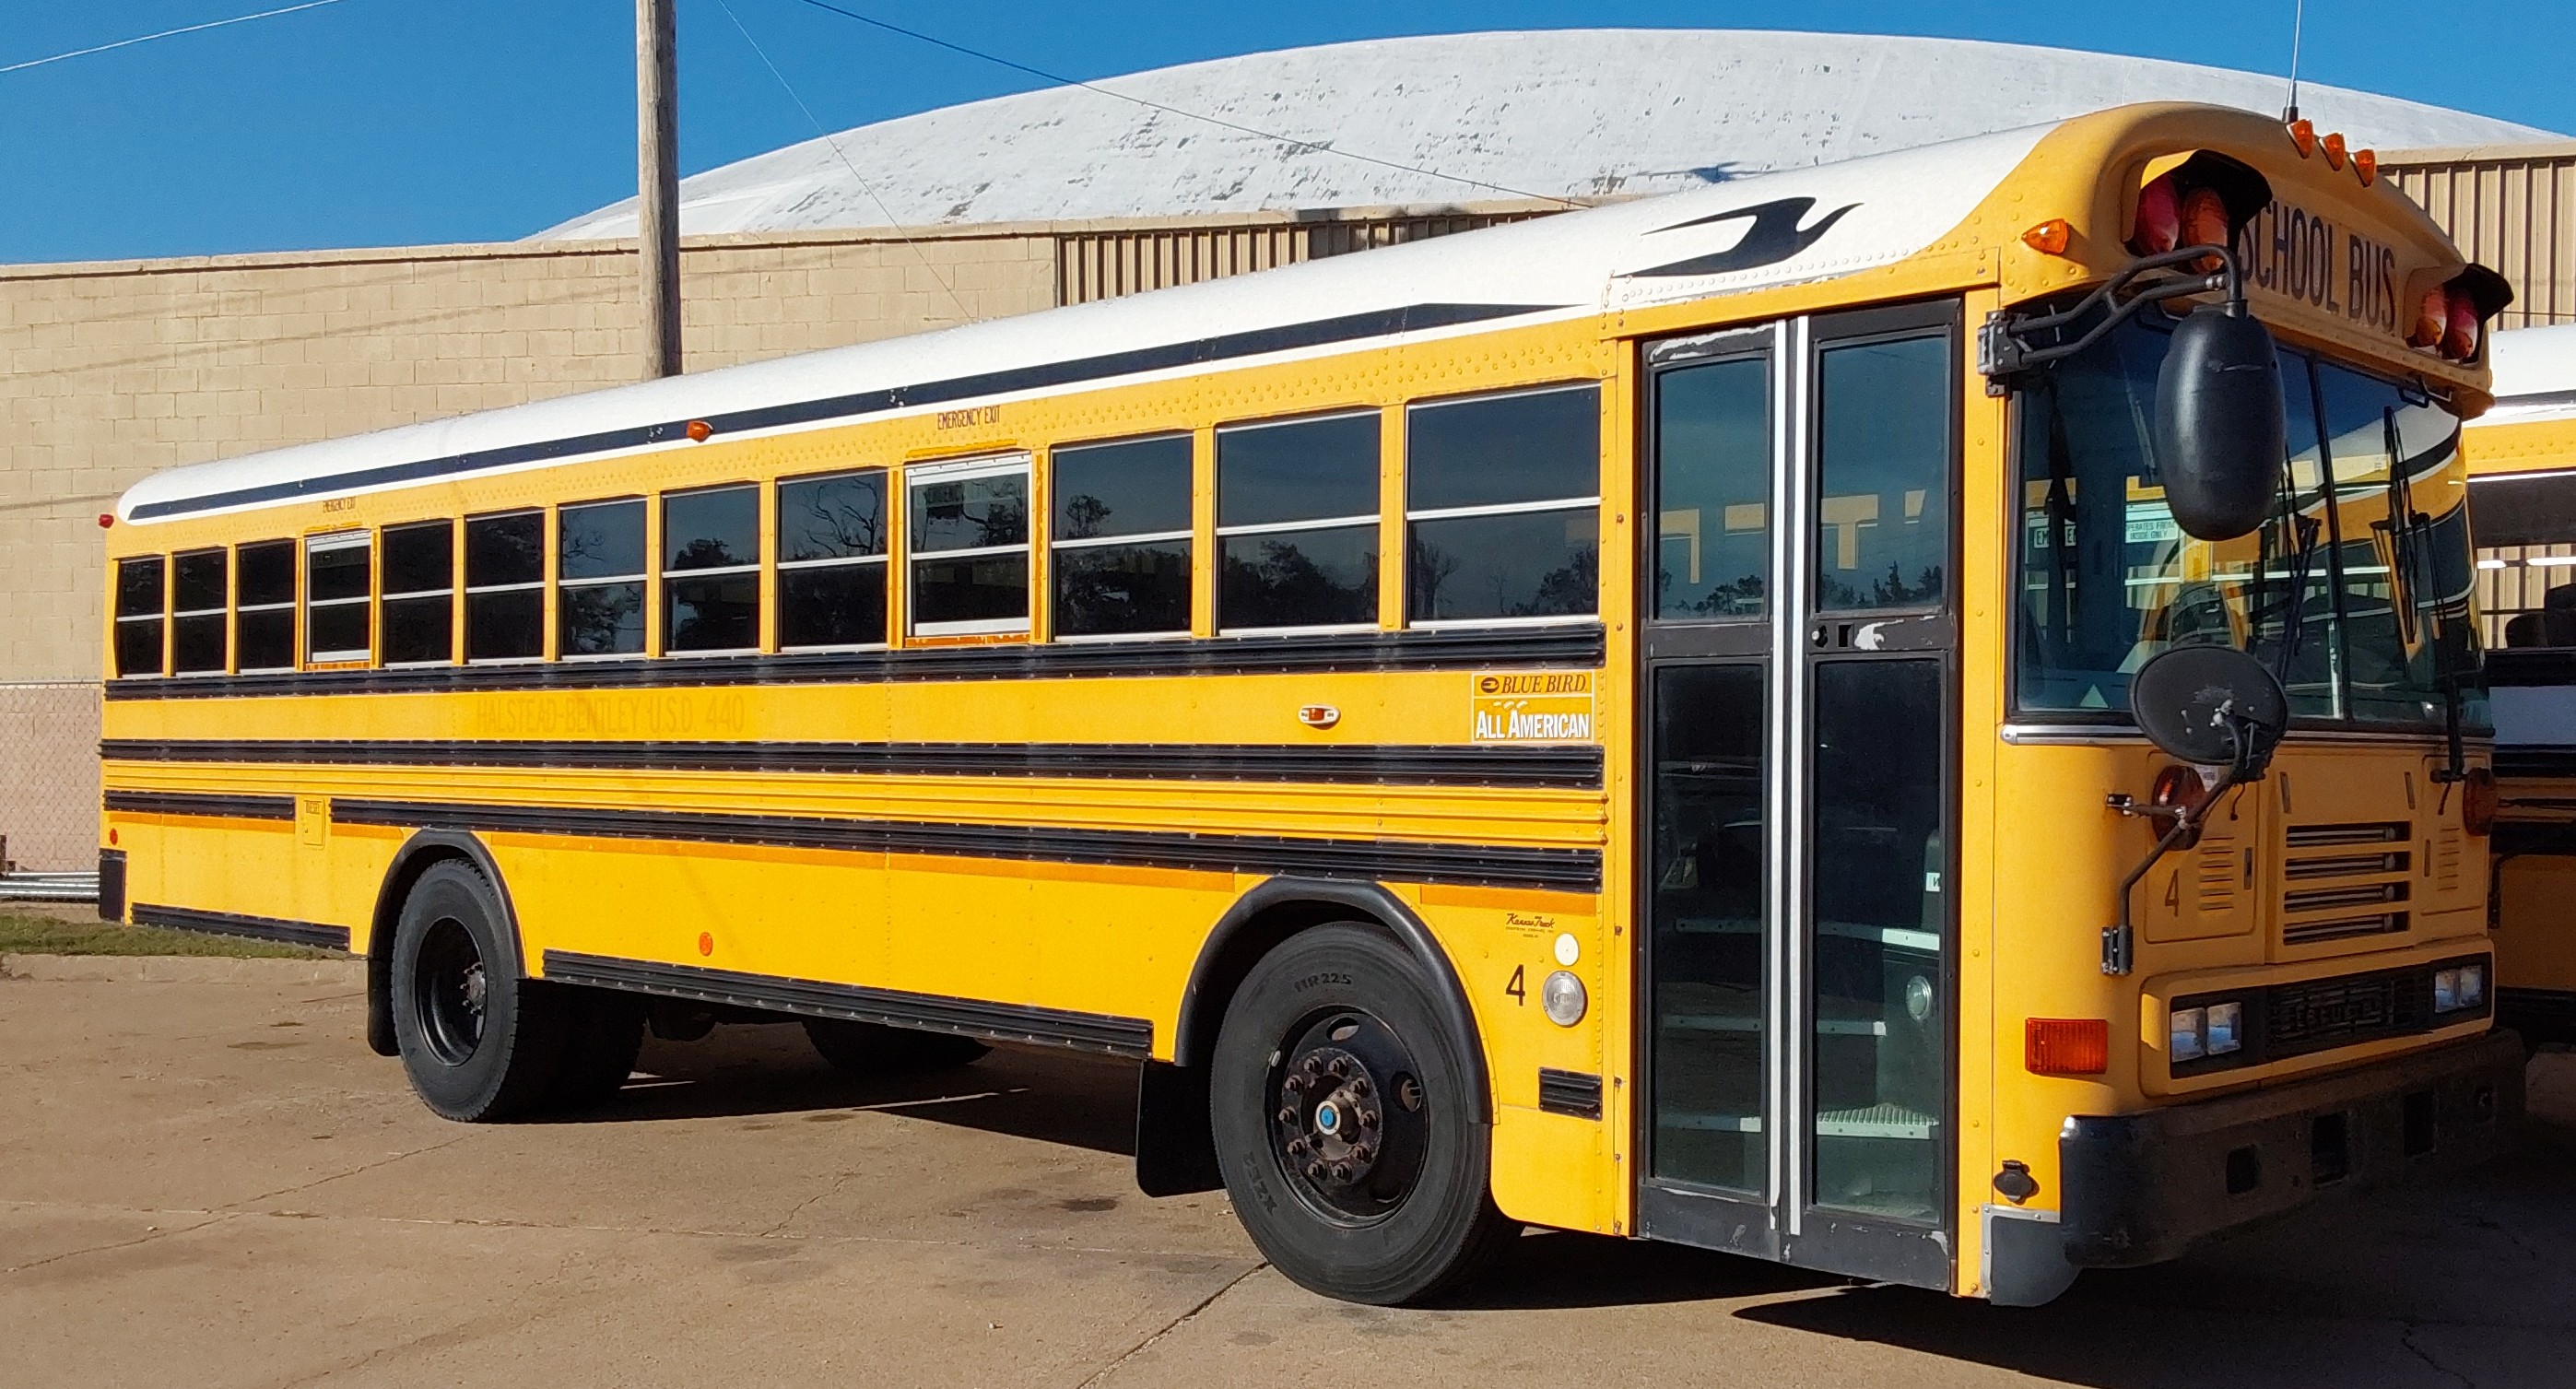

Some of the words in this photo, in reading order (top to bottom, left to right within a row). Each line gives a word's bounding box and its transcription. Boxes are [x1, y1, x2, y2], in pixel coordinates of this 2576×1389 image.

[2238, 201, 2340, 315] SCHOOL
[2349, 234, 2396, 334] BUS
[937, 408, 982, 430] EMERGENCY
[984, 405, 1001, 424] EXIT
[1501, 676, 1543, 694] BLUE
[1546, 674, 1587, 693] BIRD
[706, 692, 745, 734] 440
[2165, 869, 2180, 917] 4
[1505, 964, 1525, 1006] 4
